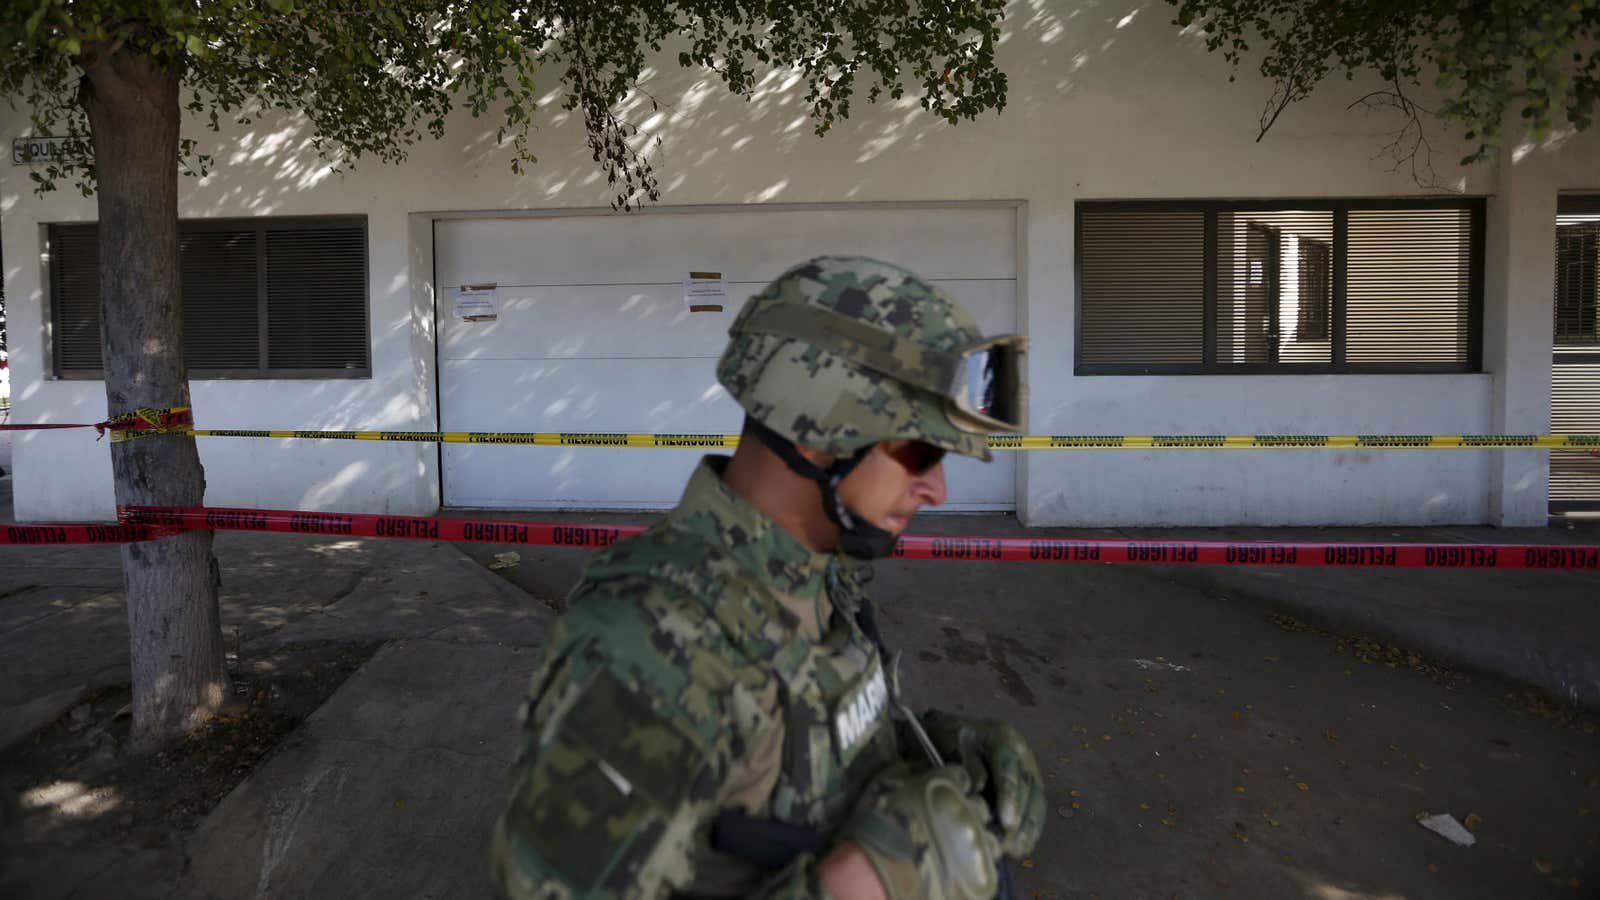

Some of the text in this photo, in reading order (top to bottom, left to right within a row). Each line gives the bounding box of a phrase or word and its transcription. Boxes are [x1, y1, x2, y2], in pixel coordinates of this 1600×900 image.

[8, 527, 66, 544] PELIGRO
[206, 511, 267, 530] PELIGRO
[290, 514, 352, 534] PELIGRO
[376, 517, 438, 538] PELIGRO
[464, 522, 528, 543] PELIGRO
[553, 526, 619, 546] PELIGRO
[931, 538, 1598, 568] PELIGRO PELIGRO PELIGRO PELIGRO PELIGRO PELIGRO PELIGRO
